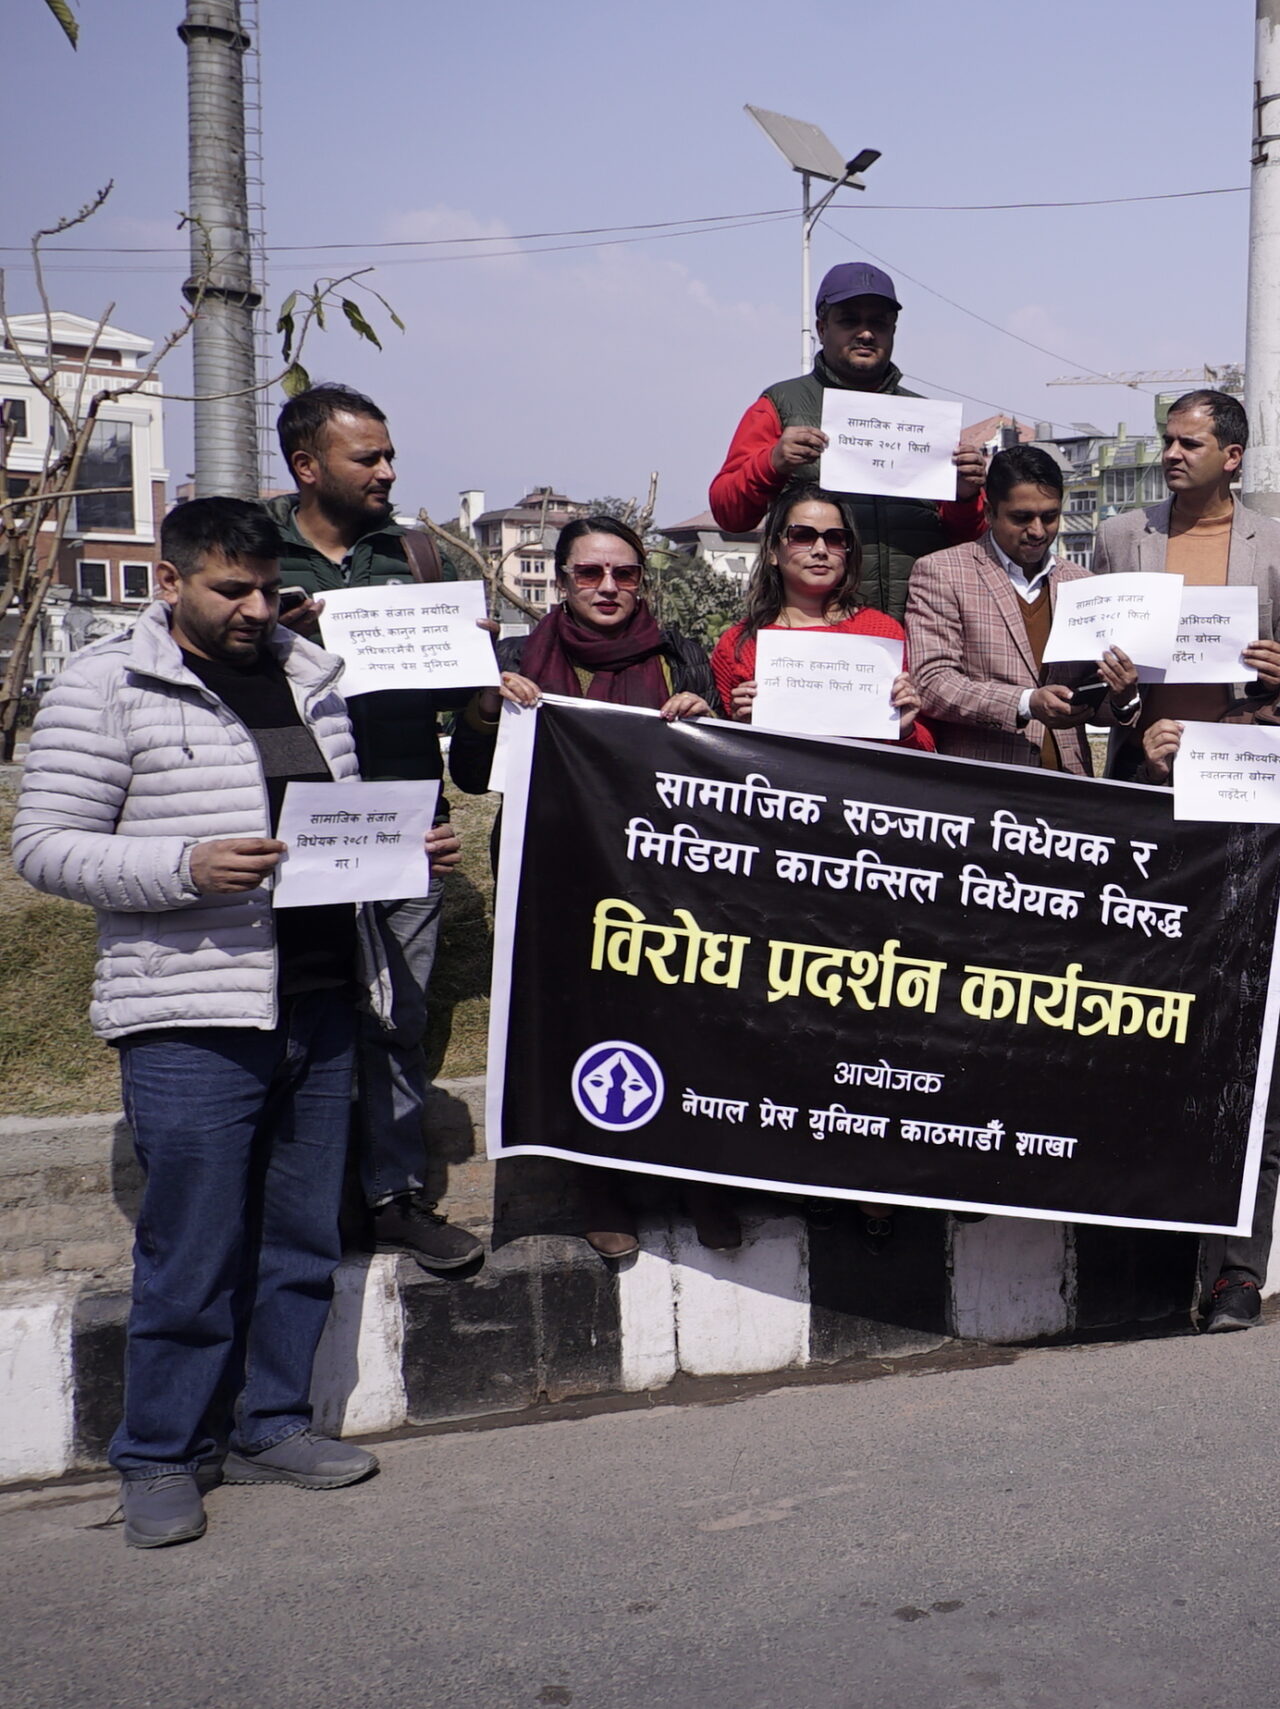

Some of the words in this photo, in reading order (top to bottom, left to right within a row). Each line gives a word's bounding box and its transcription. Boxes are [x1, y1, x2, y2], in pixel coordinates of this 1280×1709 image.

[848, 418, 892, 430] सामाजिक
[896, 421, 925, 433] संजाल
[838, 434, 874, 448] विधेयक
[879, 440, 901, 450] २०८१
[908, 441, 930, 453] फिर्ता
[872, 459, 886, 469] गर
[1076, 596, 1112, 610] सामाजिक
[331, 608, 380, 621] सामाजिक
[386, 606, 415, 618] संजाल
[421, 603, 460, 615] मर्यादित
[422, 625, 449, 634] मानव
[1195, 633, 1221, 643] खोस्न
[401, 662, 417, 670] प्रेस
[770, 657, 805, 669] मौलिक
[810, 660, 850, 671] हकमाथि
[855, 663, 875, 673] घात
[787, 677, 824, 689] विधेयक
[829, 680, 853, 691] फिर्ता
[1190, 750, 1205, 760] प्रेस
[1200, 770, 1243, 781] स्वतन्त्रता
[1248, 771, 1276, 781] खोस्न
[310, 811, 362, 824] सामाजिक
[367, 809, 398, 823] संजाल
[654, 771, 828, 827] सामाजिक
[841, 797, 975, 849] सञ्जाल
[989, 809, 1116, 866] विधेयक
[1128, 840, 1158, 879] र
[297, 835, 338, 847] विधेयक
[343, 836, 368, 845] २०८१
[376, 831, 401, 844] फिर्ता
[335, 859, 351, 869] गर
[623, 816, 761, 878] मिडिया
[775, 847, 943, 904] काउन्सिल
[959, 864, 1086, 921] विधेयक
[1099, 882, 1189, 940] विरुद्ध
[589, 897, 752, 991] विरोध
[765, 939, 947, 1015] प्रदर्शन
[959, 961, 1197, 1045] कार्यक्रम
[833, 1058, 946, 1096] आयोजक
[680, 1087, 749, 1126] नेपाल
[758, 1097, 800, 1133] प्रेस
[807, 1107, 888, 1143] युनियन
[1014, 1129, 1078, 1160] शाखा
